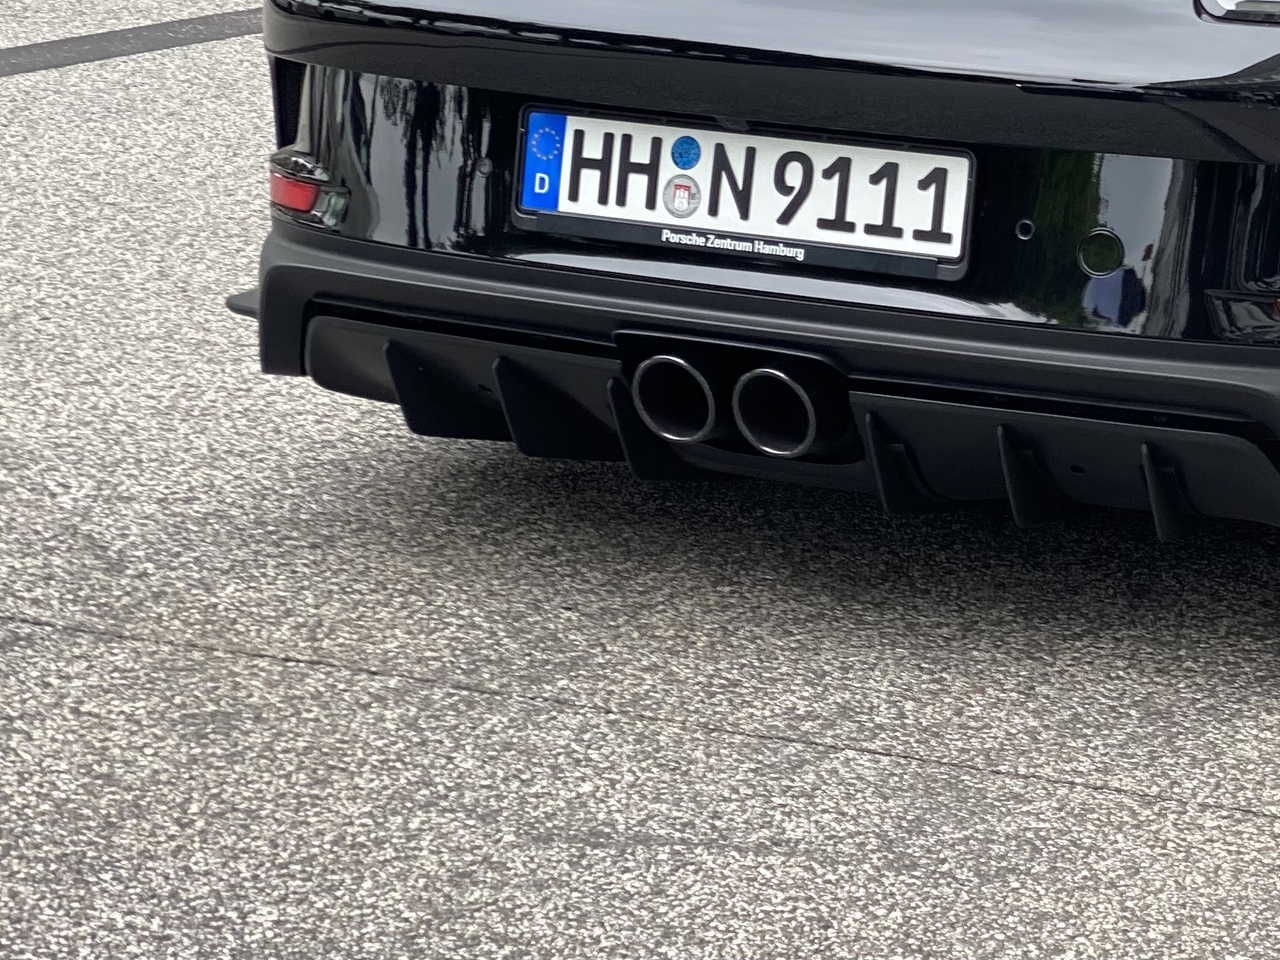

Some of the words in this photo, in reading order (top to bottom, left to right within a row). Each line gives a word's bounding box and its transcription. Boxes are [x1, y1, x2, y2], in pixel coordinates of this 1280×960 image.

[534, 172, 550, 194] D
[567, 128, 663, 211] HH
[707, 142, 757, 221] N
[773, 150, 954, 244] 9111
[661, 229, 705, 247] Porsche
[706, 234, 752, 252] Zentrum
[754, 238, 805, 261] Hamburg
